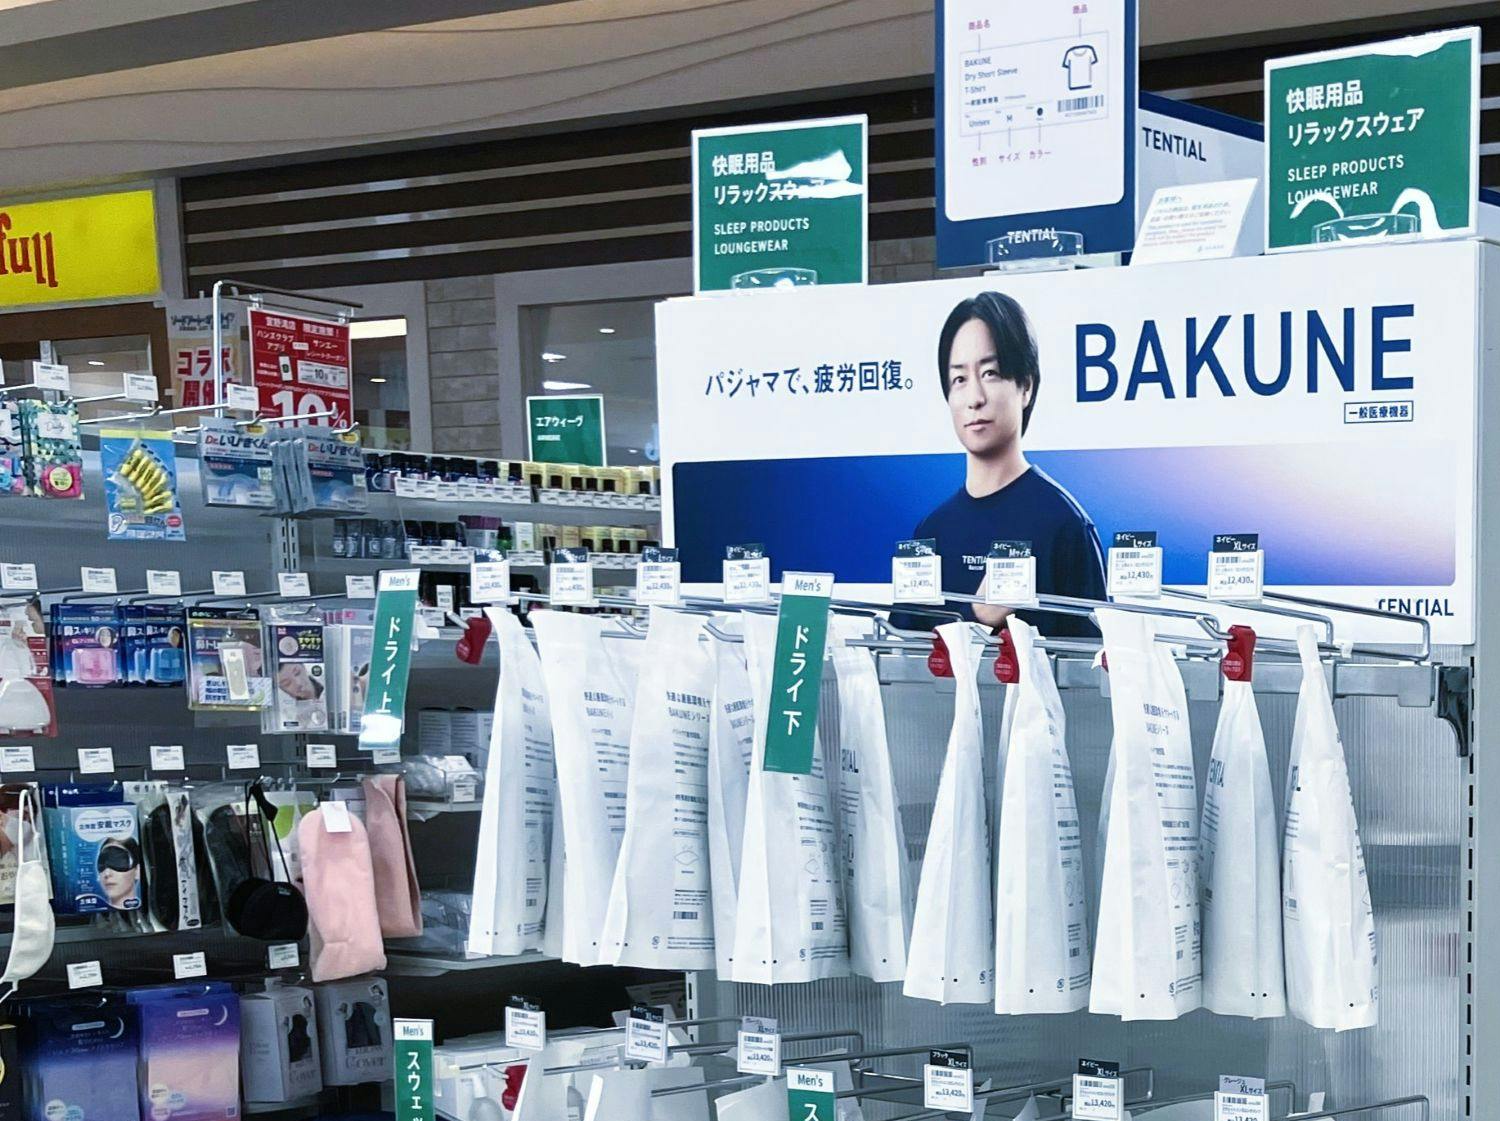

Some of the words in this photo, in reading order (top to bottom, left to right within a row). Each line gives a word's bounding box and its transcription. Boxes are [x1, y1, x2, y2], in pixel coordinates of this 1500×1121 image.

[1286, 79, 1364, 114] 快眠用品
[1288, 107, 1425, 147] リラックスウェア
[1142, 126, 1207, 162] TENTIAL
[711, 150, 776, 177] 快眠用品
[1287, 164, 1328, 182] SLEEP
[1332, 154, 1405, 177] PRODUCTS
[1287, 181, 1378, 205] LOUNGEWEAR
[713, 222, 748, 236] SLEEP
[751, 217, 811, 233] PRODUCTS
[1007, 226, 1058, 244] TENTIAL
[713, 239, 789, 255] LOUNGEWEAR
[1076, 304, 1415, 403] BAKUNE
[705, 359, 914, 398] パジャマで、疲労回復。
[1348, 405, 1409, 420] 一般医療機器
[1132, 539, 1153, 548] Lサイズ
[1233, 541, 1256, 551] XLサイズ
[389, 575, 411, 587] Men's
[794, 577, 822, 592] Men's
[376, 616, 401, 713] ドライ上
[783, 625, 809, 736] ドライ下
[402, 1026, 424, 1037] Men's
[931, 1051, 949, 1059] ブラック
[947, 1059, 967, 1068] XLサイズ
[798, 1073, 823, 1088] Men's
[1097, 1067, 1119, 1077] XLサイズ
[1239, 1084, 1263, 1095] XLサイズ
